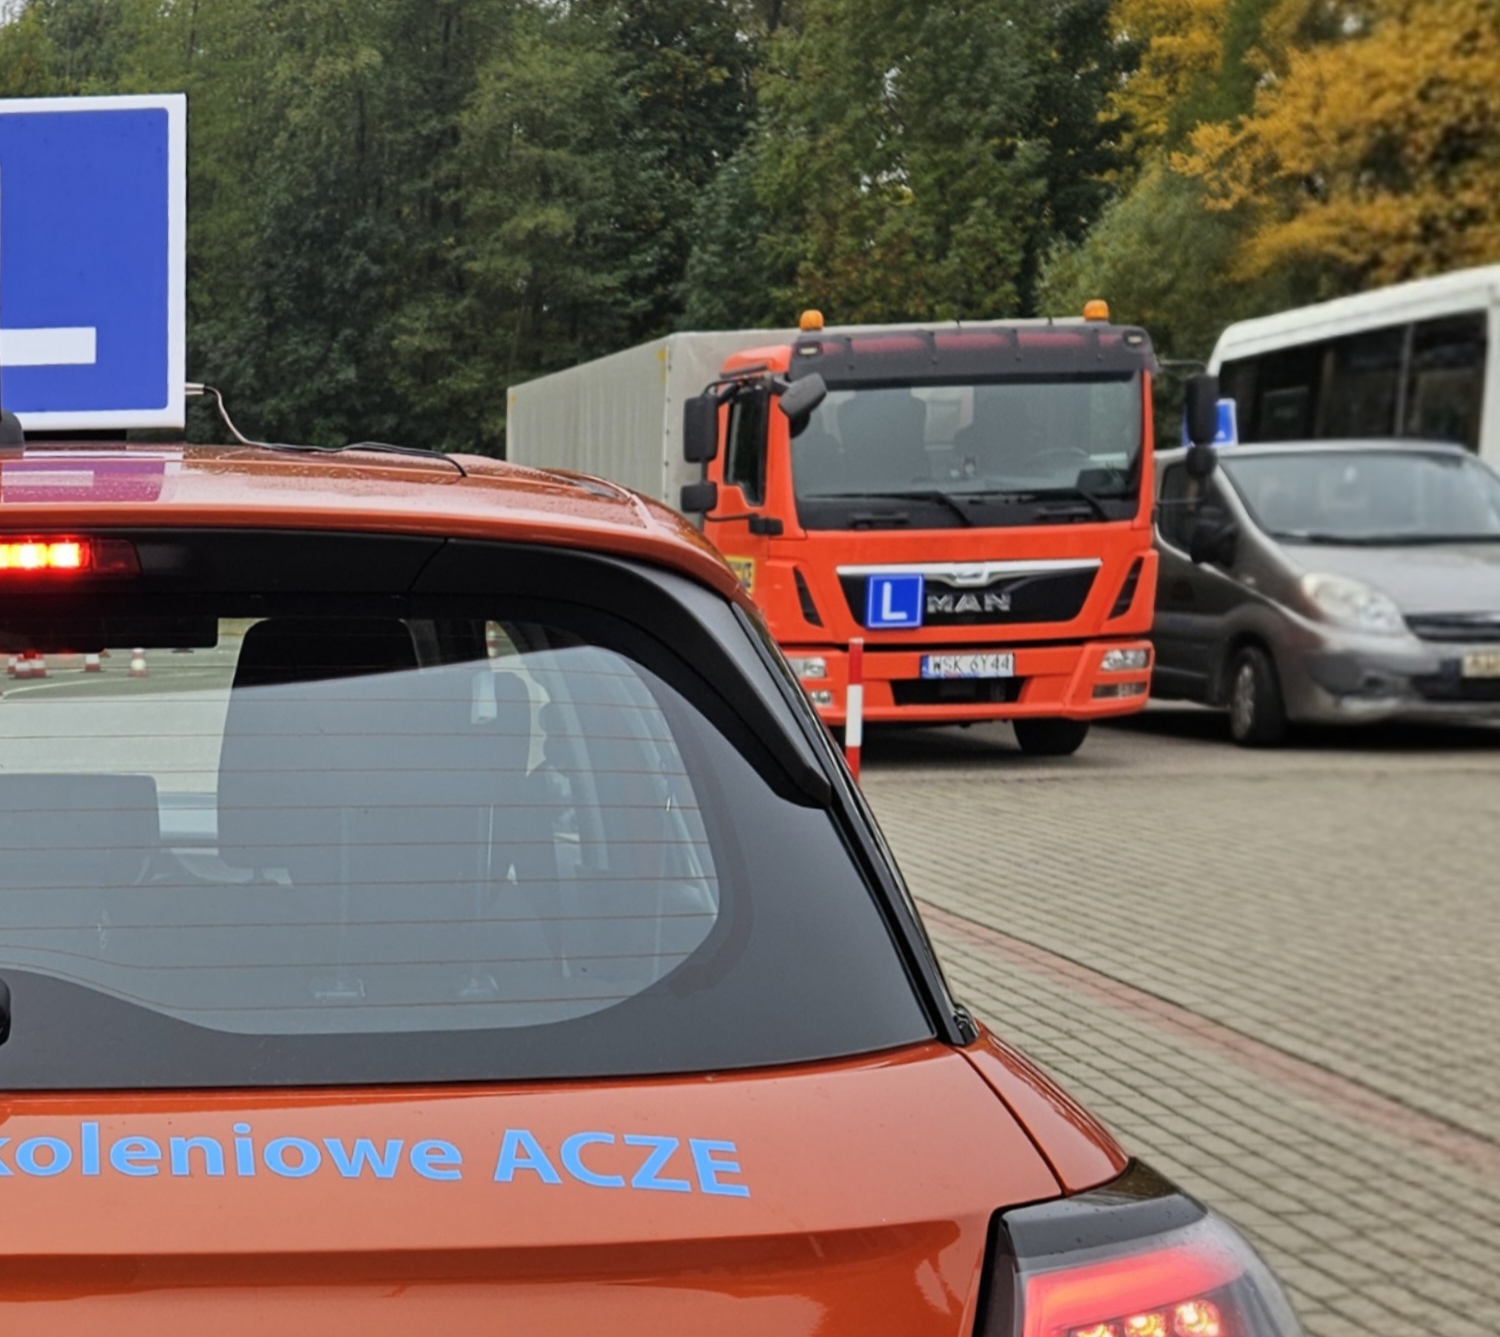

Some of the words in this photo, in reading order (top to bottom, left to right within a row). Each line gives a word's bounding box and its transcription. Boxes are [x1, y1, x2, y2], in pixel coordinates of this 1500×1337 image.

[882, 582, 908, 621] L
[926, 591, 1012, 614] MAN
[493, 1128, 751, 1199] ACZE
